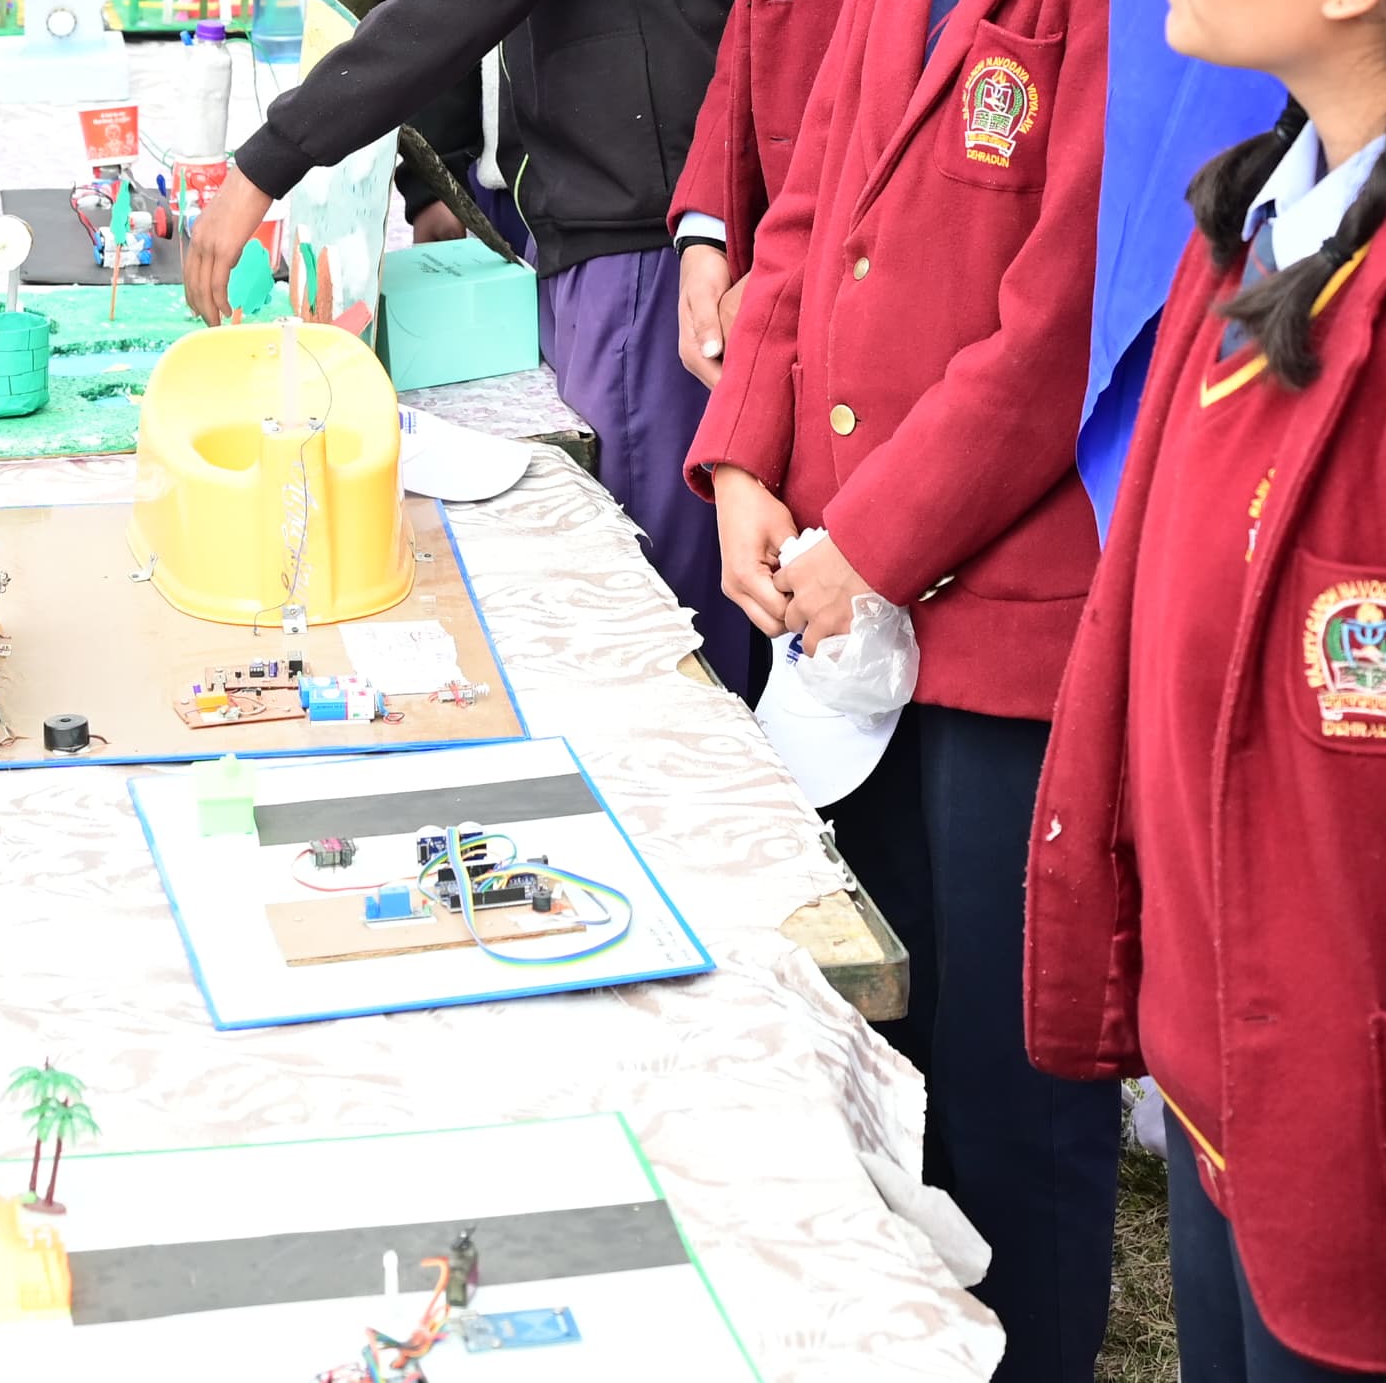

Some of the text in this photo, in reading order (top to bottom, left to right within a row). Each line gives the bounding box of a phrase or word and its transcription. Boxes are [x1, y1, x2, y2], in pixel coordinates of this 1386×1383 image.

[985, 56, 1030, 84] NAVODAYA
[1018, 82, 1039, 135] VIDYALAYA
[966, 148, 1010, 169] DEHRADUN
